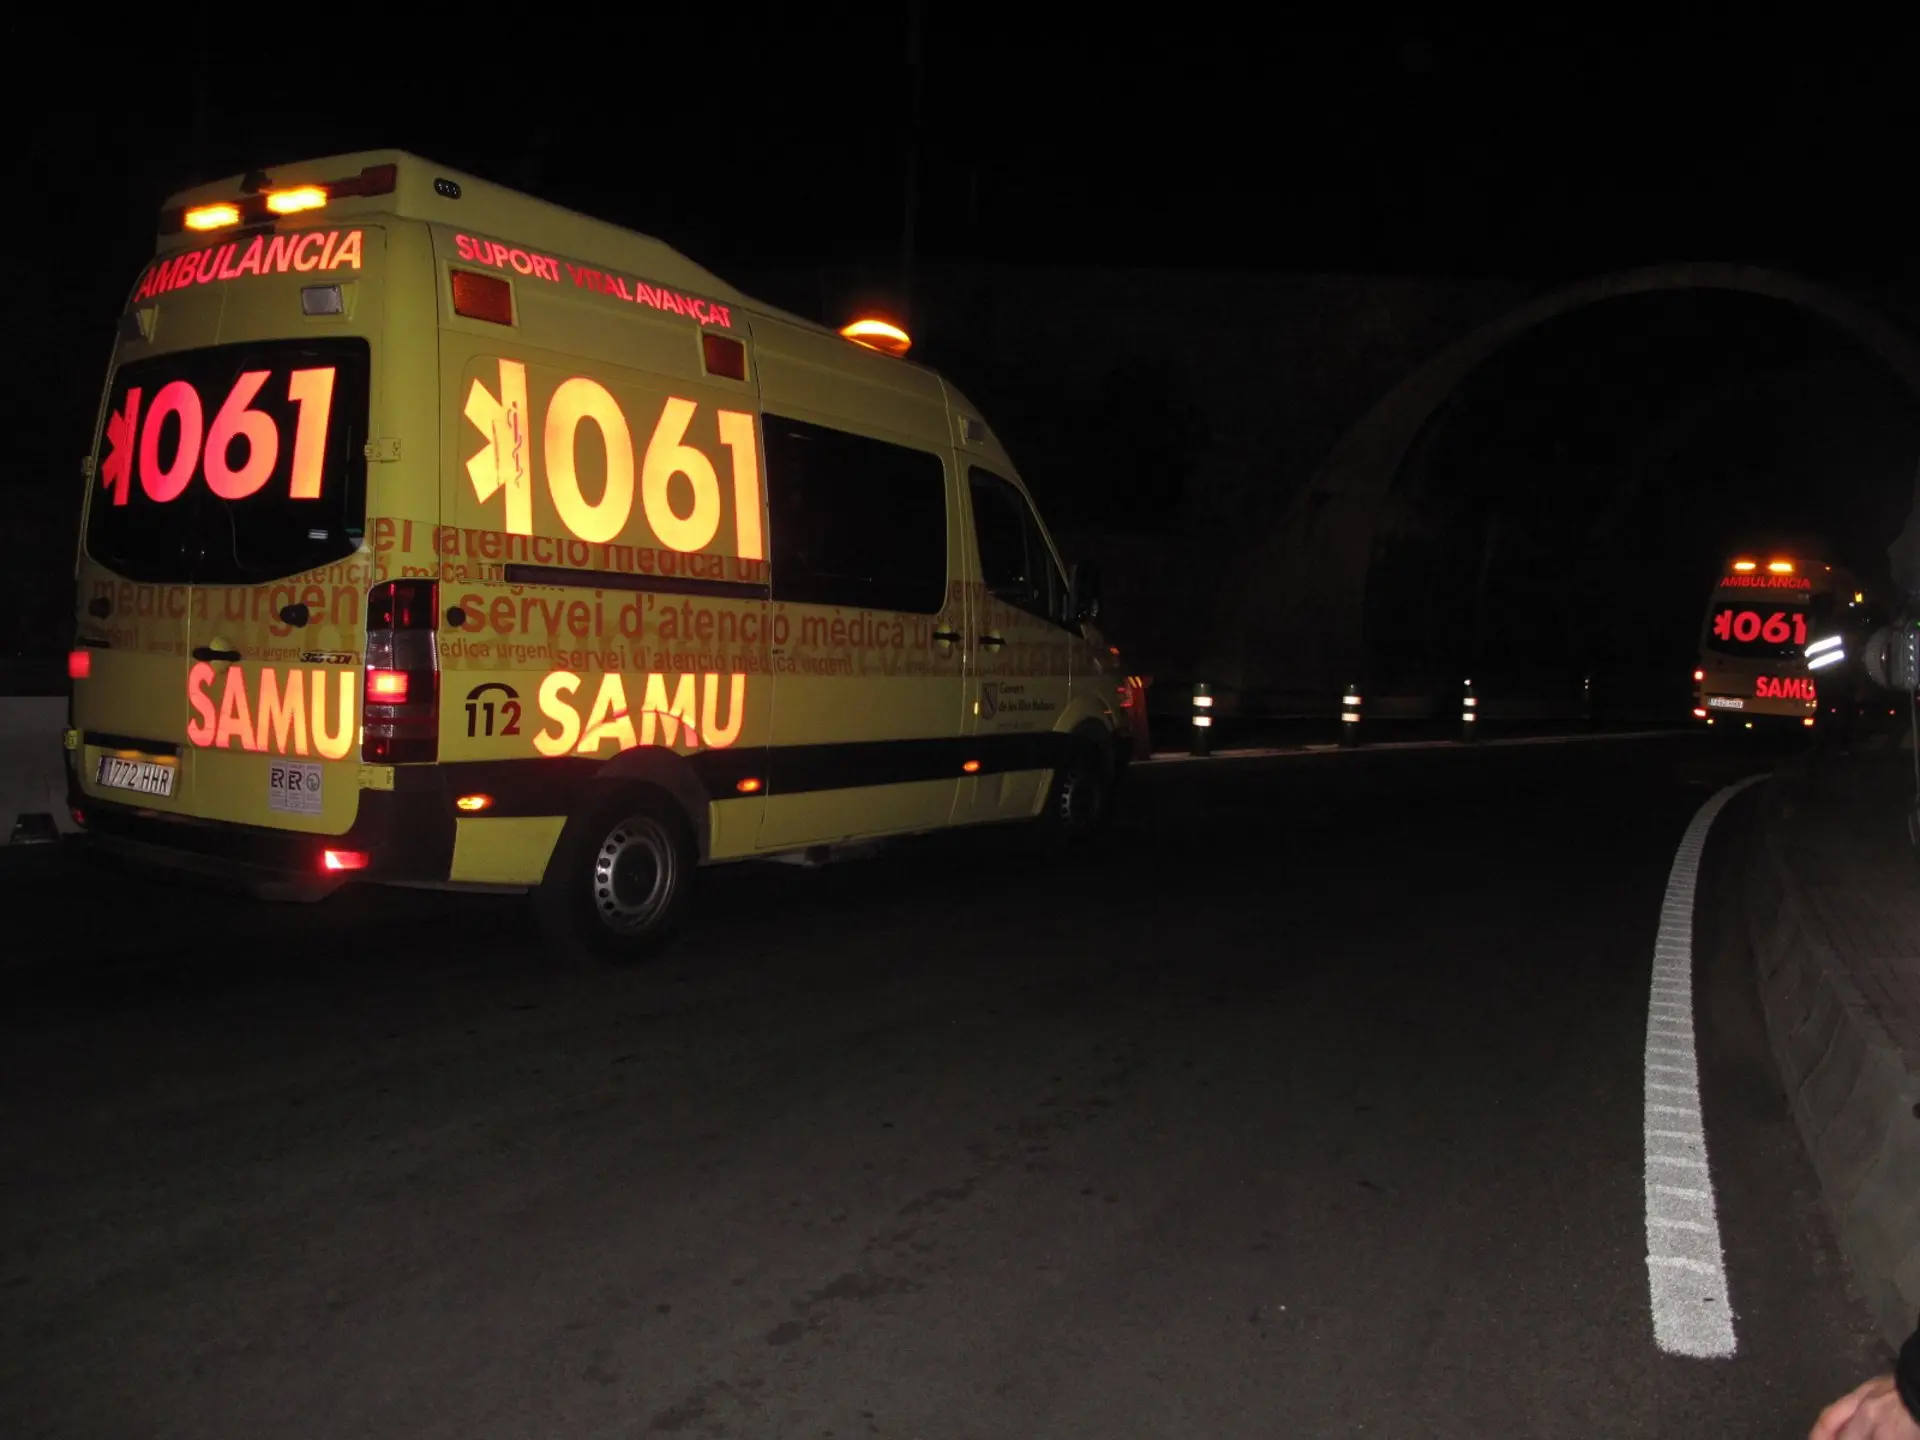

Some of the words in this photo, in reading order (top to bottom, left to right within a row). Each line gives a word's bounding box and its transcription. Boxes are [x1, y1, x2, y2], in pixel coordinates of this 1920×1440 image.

[455, 234, 560, 282] SUPORT
[566, 263, 634, 303] VITAL
[636, 281, 732, 328] AVANÇAT
[140, 366, 336, 503] 061
[544, 377, 763, 561] 061
[459, 590, 603, 638] servei
[801, 608, 905, 649] mèdica
[1733, 610, 1808, 645] 061
[556, 644, 625, 671] servei
[187, 661, 357, 761] SAMU
[533, 670, 747, 758] SAMU
[1755, 675, 1816, 700] SAMU
[465, 702, 521, 738] 112
[108, 758, 138, 787] 1772
[142, 763, 170, 793] HHR
